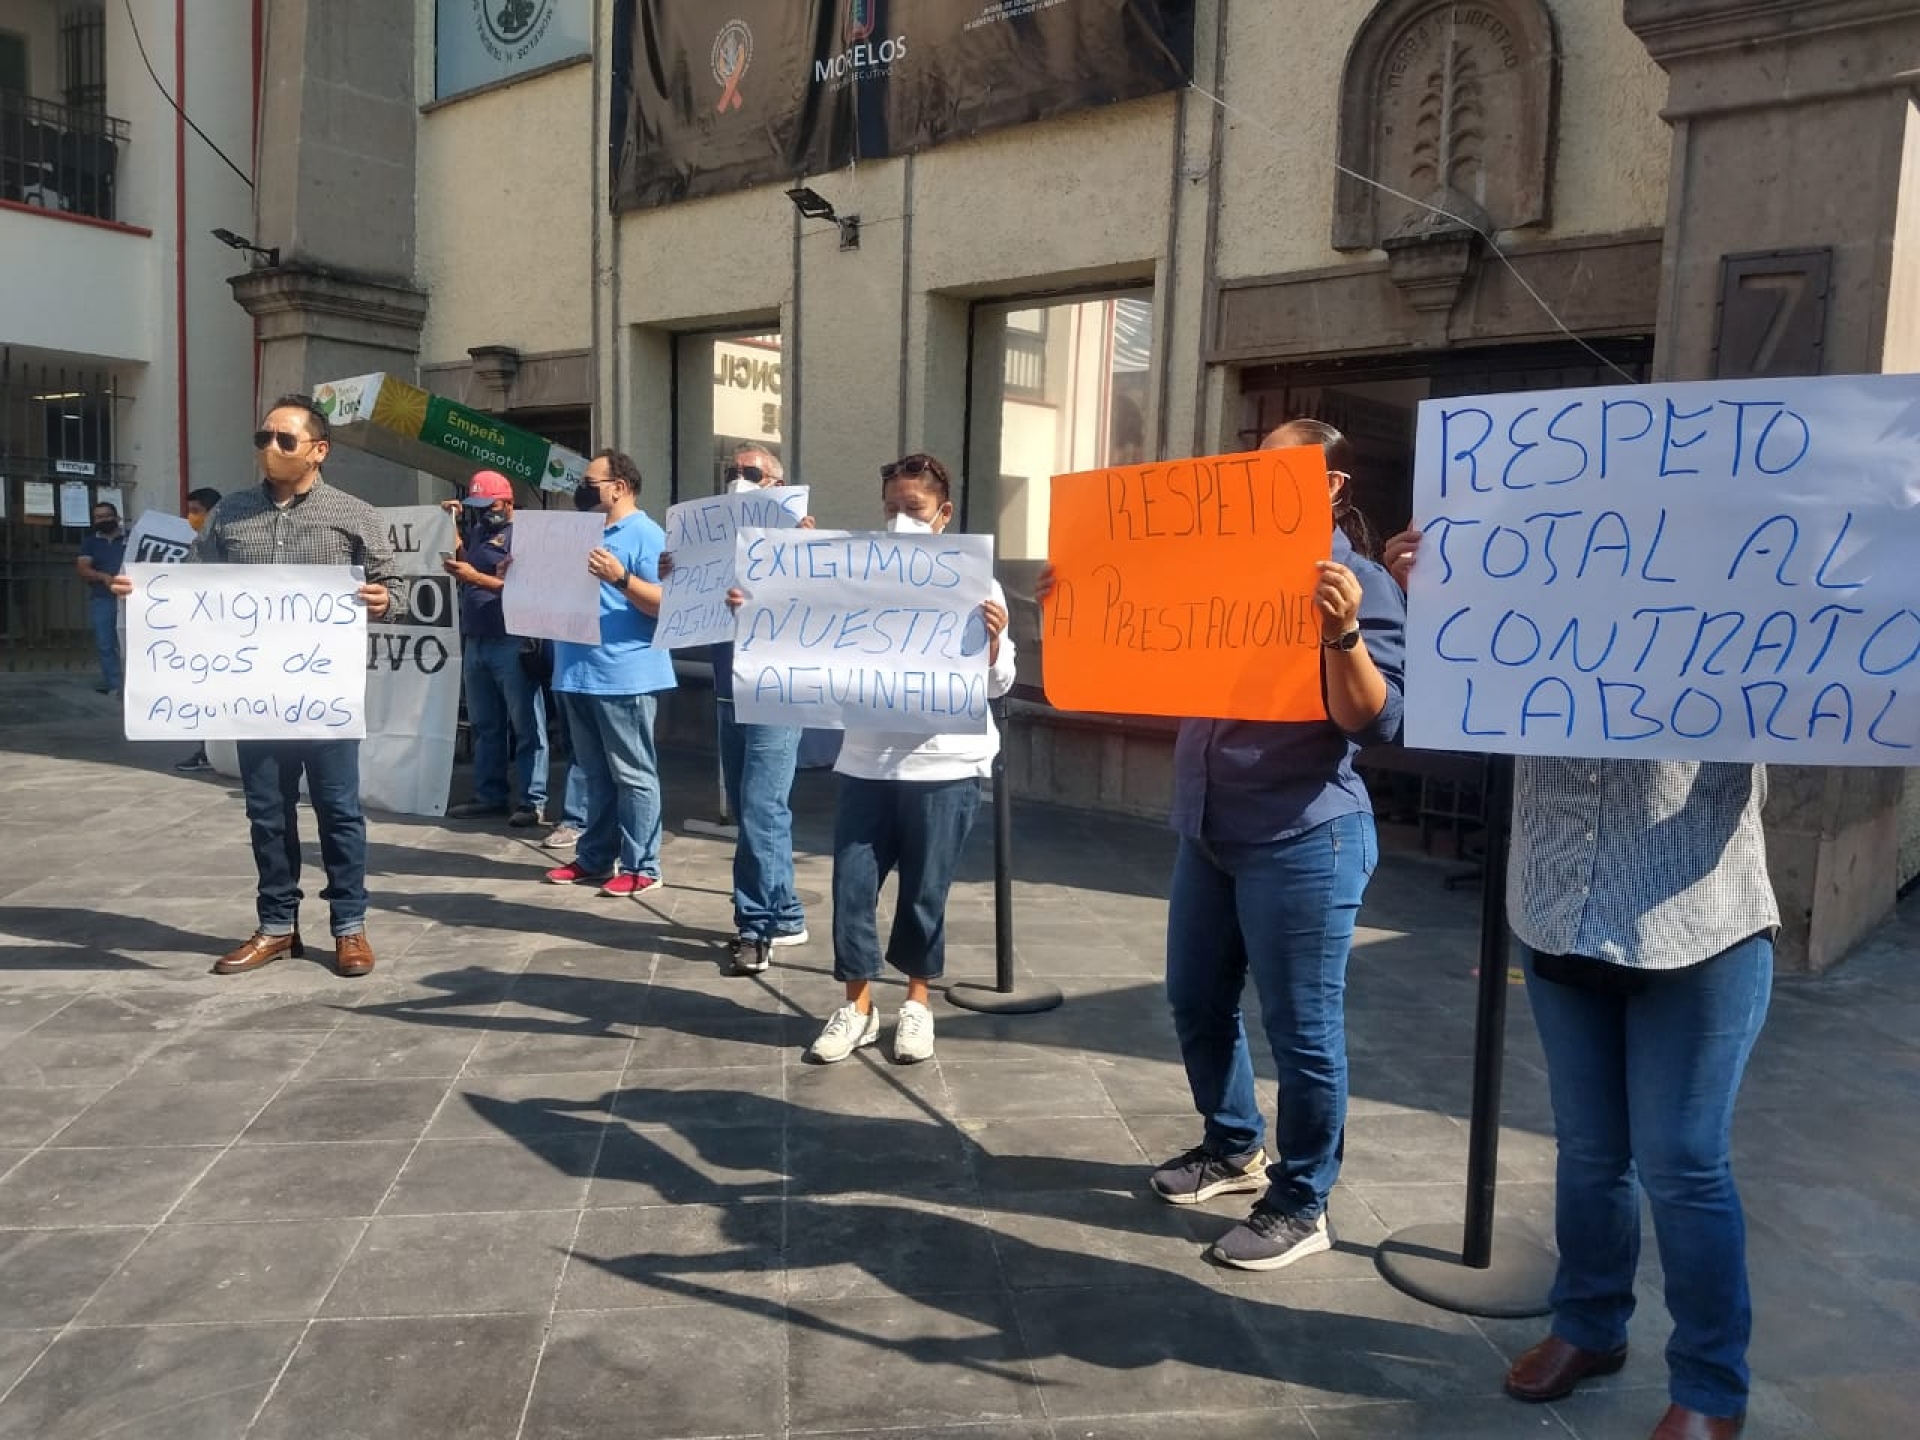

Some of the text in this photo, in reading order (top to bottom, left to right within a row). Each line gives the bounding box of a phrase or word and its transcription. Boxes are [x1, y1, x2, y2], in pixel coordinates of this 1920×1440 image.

[815, 35, 907, 82] MORELOS
[1740, 269, 1807, 374] 7
[443, 433, 469, 452] con
[447, 410, 505, 446] Empeña
[1440, 398, 1810, 498] RESPETO
[1107, 458, 1303, 541] RESPETO
[747, 538, 961, 588] EXIGIMOS
[1422, 508, 1868, 589] TOTAL AL
[1052, 564, 1322, 651] A PRESTACIONES
[1436, 603, 1920, 677] CONTRATO
[147, 640, 332, 684] Pagos de
[755, 666, 987, 721] AGUINALDO
[1462, 676, 1911, 749] LABORAL
